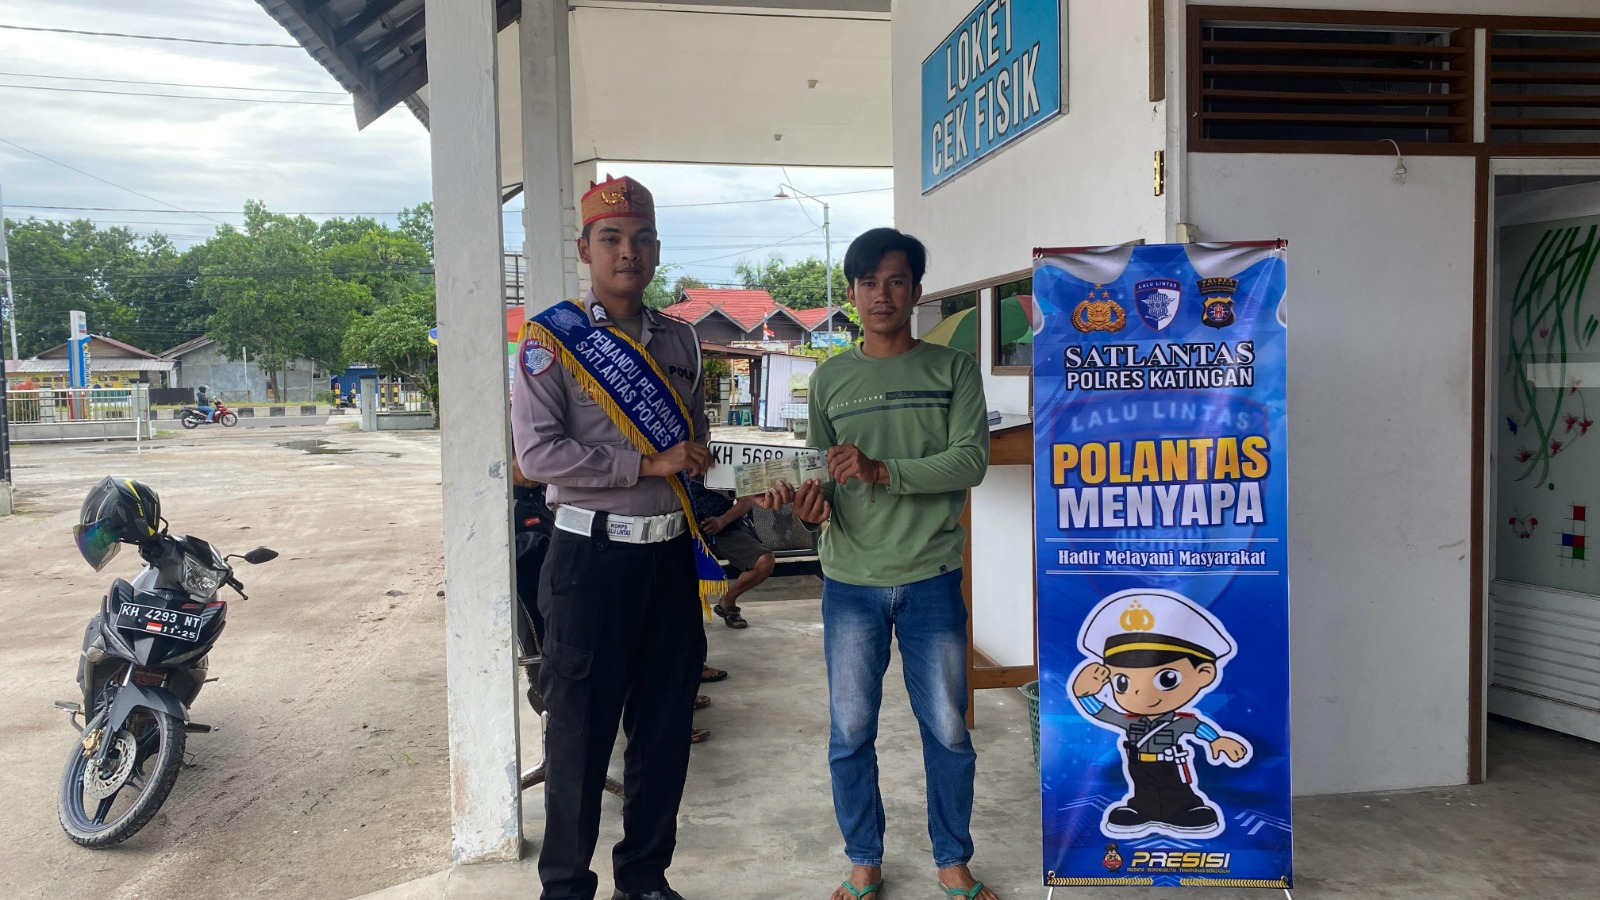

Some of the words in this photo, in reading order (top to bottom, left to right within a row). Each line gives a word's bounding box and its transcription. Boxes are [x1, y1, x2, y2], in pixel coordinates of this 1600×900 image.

[946, 0, 1012, 102] LOKET
[932, 99, 968, 176] CEK
[974, 41, 1040, 150] FISIK
[586, 329, 642, 380] PEMANDU
[1065, 341, 1255, 368] SATLANTAS
[575, 340, 637, 404] SATLANTAS
[632, 400, 672, 448] POLRES
[1067, 370, 1144, 390] POLRES
[1150, 367, 1254, 389] KATINGAN
[1070, 404, 1138, 433] LALU
[1153, 401, 1249, 430] LINTAS
[712, 445, 733, 465] KH
[1053, 436, 1269, 485] POLANTAS
[1058, 481, 1264, 529] MENYAPA
[1058, 549, 1101, 565] Hadir
[1105, 549, 1174, 567] Melayani
[1179, 549, 1266, 567] Masyarakat
[121, 605, 140, 617] KH
[145, 608, 178, 623] 4293
[184, 615, 201, 628] NT
[1131, 851, 1231, 868] PRESISI
